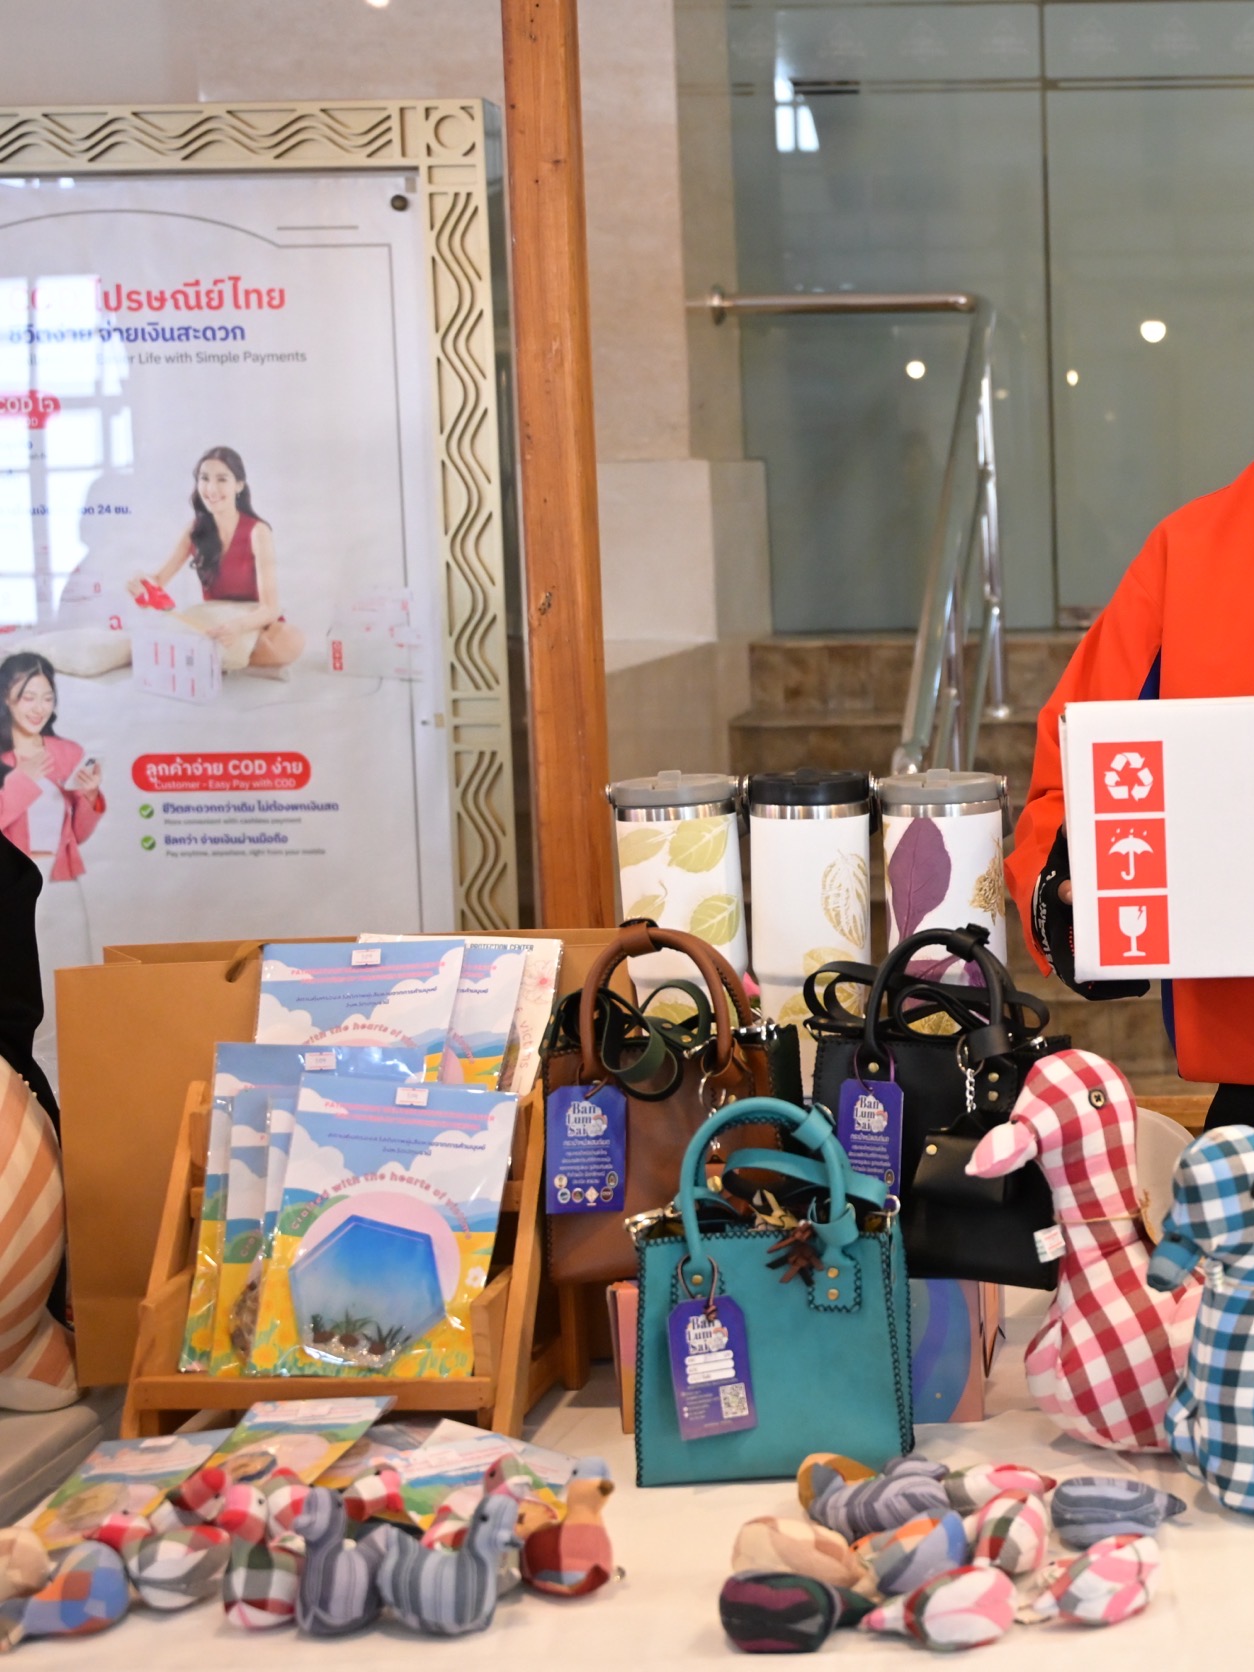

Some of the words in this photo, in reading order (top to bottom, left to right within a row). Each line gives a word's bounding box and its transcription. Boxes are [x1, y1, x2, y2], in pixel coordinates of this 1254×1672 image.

[99, 320, 246, 343] จ่ายเงินสะดวก
[138, 352, 162, 364] Life
[164, 351, 193, 364] with
[195, 351, 240, 366] Simple
[243, 350, 307, 366] Payments
[97, 504, 112, 514] 24
[146, 756, 224, 782] ลูกค้าจ่าย
[228, 759, 267, 776] COD
[271, 756, 303, 775] ง่าย
[155, 779, 201, 790] Customer
[208, 780, 231, 791] Easy
[232, 779, 251, 790] Pay
[252, 778, 274, 788] with
[275, 778, 296, 788] COD
[572, 1102, 596, 1115] Ban
[364, 1172, 386, 1182] the
[390, 1171, 431, 1191] hearts
